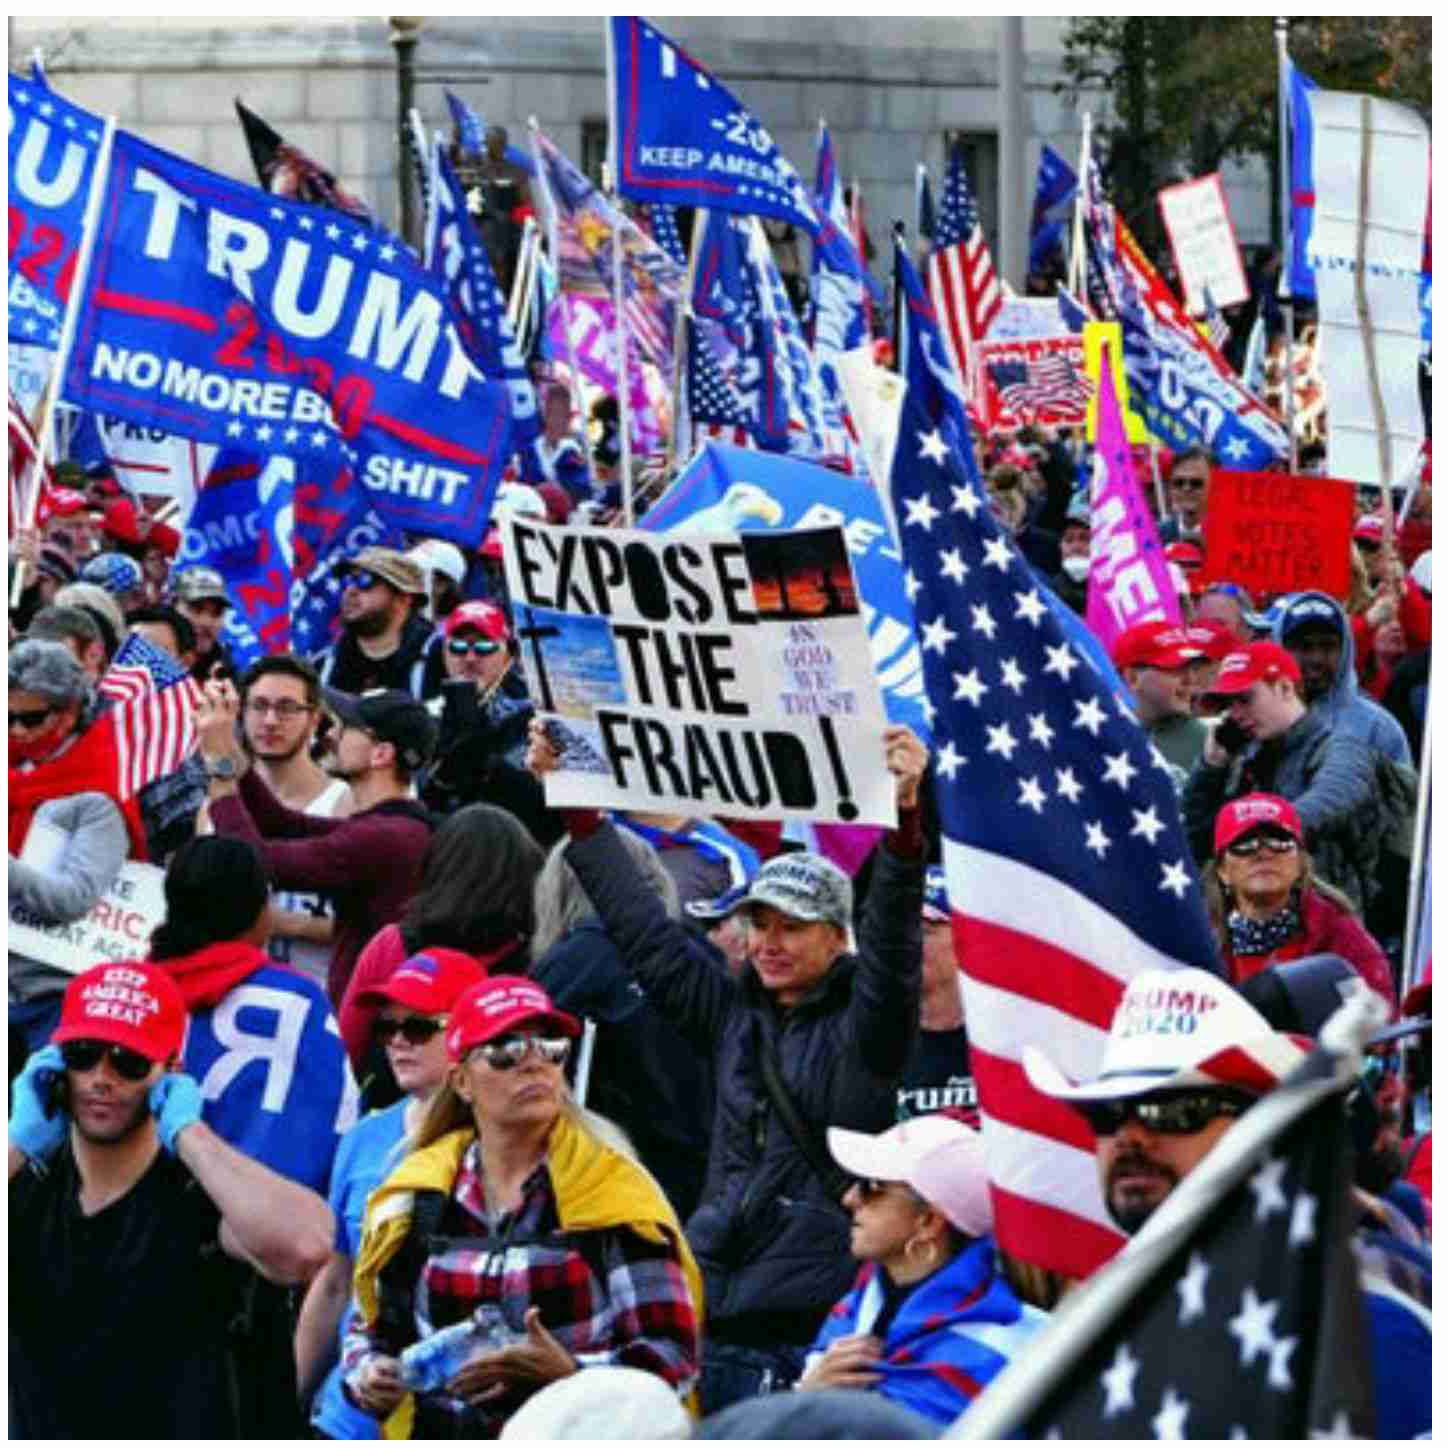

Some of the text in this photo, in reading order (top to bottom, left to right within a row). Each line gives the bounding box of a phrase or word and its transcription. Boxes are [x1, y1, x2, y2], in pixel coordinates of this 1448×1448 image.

[640, 145, 703, 168] KEEP
[361, 453, 470, 507] SHIT
[512, 522, 760, 626] EXPOSE
[613, 622, 750, 717] THE
[84, 1000, 146, 1026] GREAT
